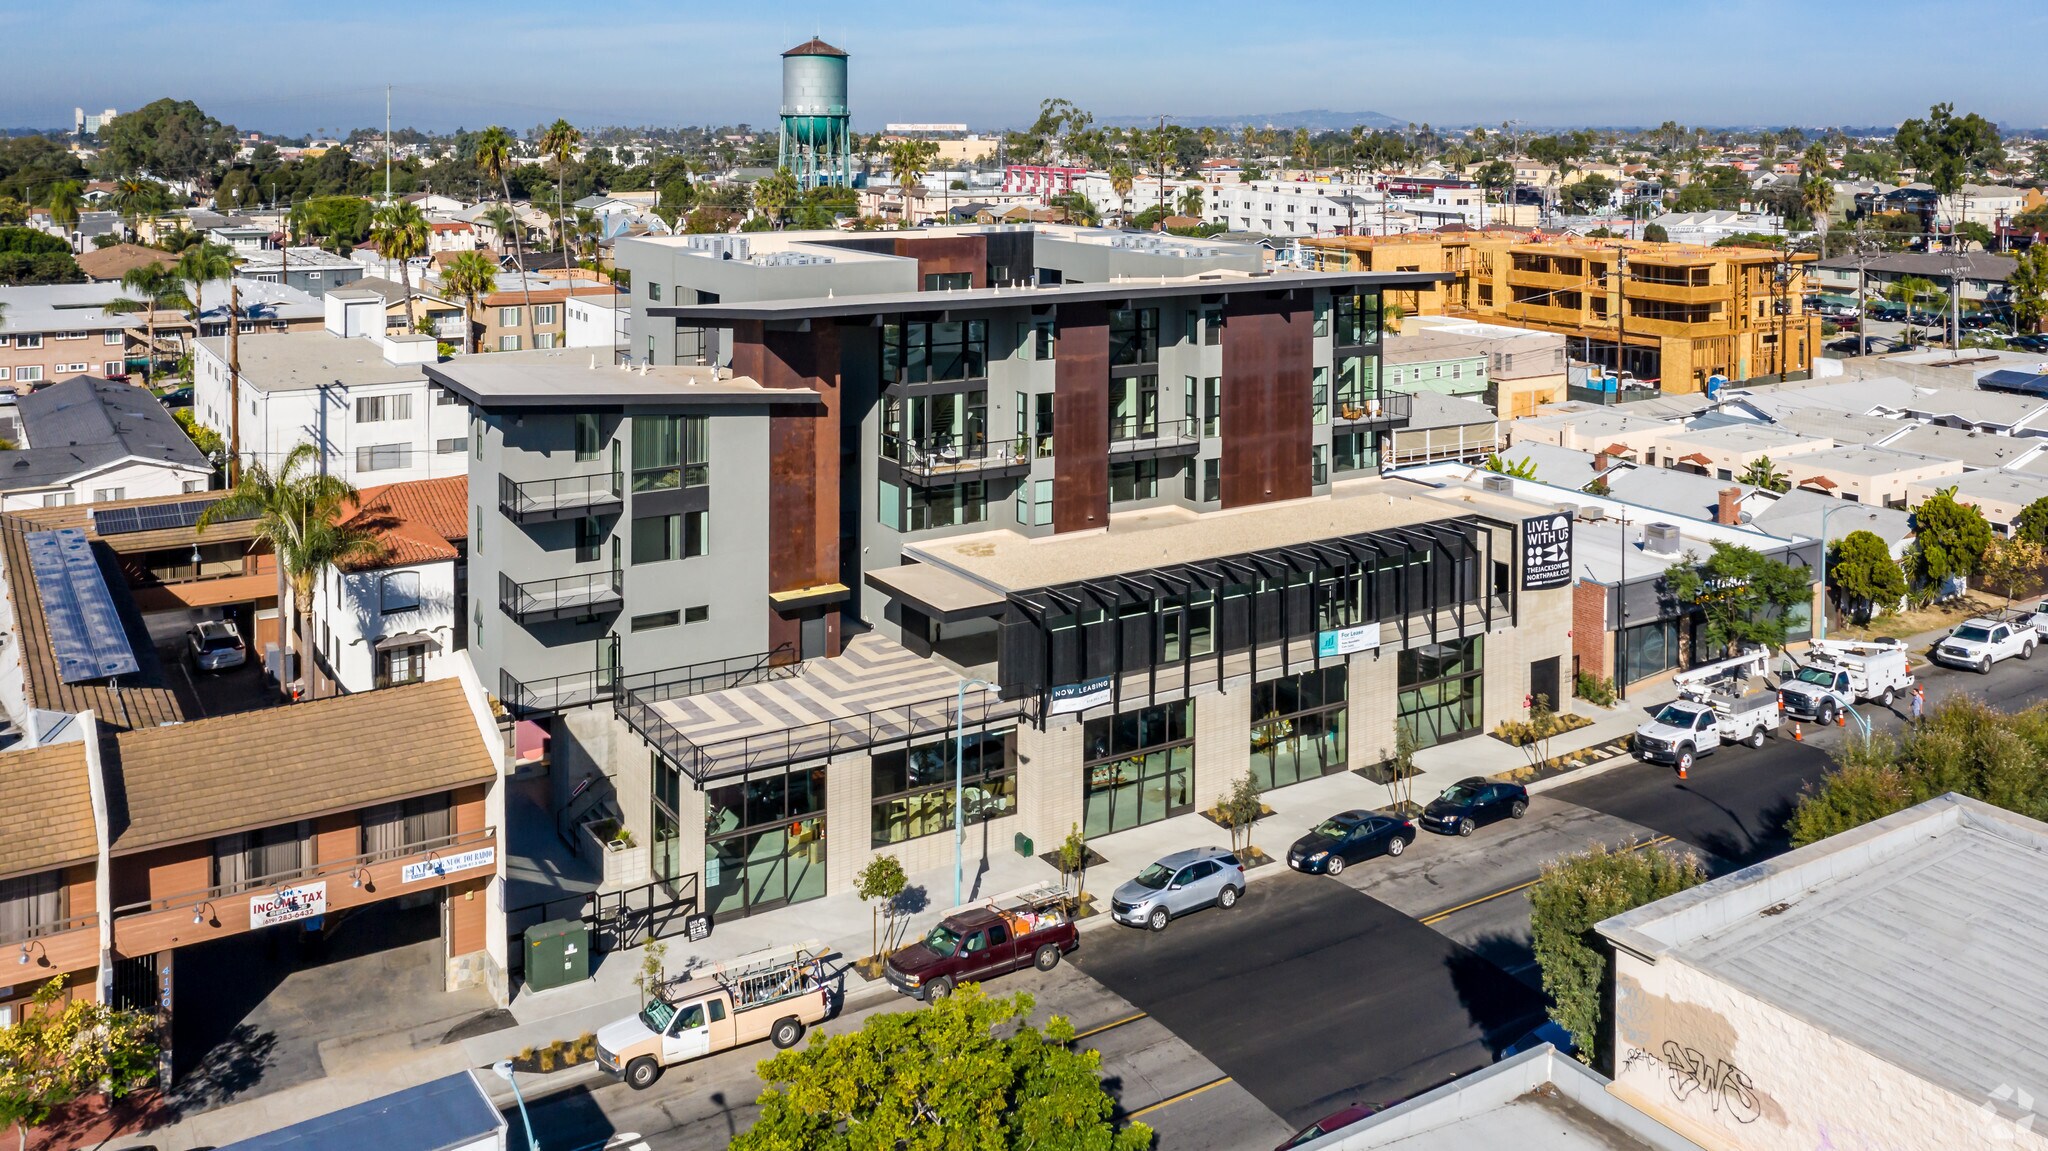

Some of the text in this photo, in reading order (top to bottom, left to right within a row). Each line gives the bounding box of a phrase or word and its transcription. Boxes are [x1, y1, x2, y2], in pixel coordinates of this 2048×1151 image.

[1527, 520, 1549, 534] LIVE
[1527, 528, 1569, 546] WITH US
[1527, 563, 1562, 574] THEJACKSON
[1527, 568, 1570, 581] NORTHPARK.COM
[1055, 680, 1108, 697] NOW LEASING
[302, 890, 323, 904] TAX
[278, 909, 314, 922] 283-6432
[162, 966, 171, 1007] 4120
